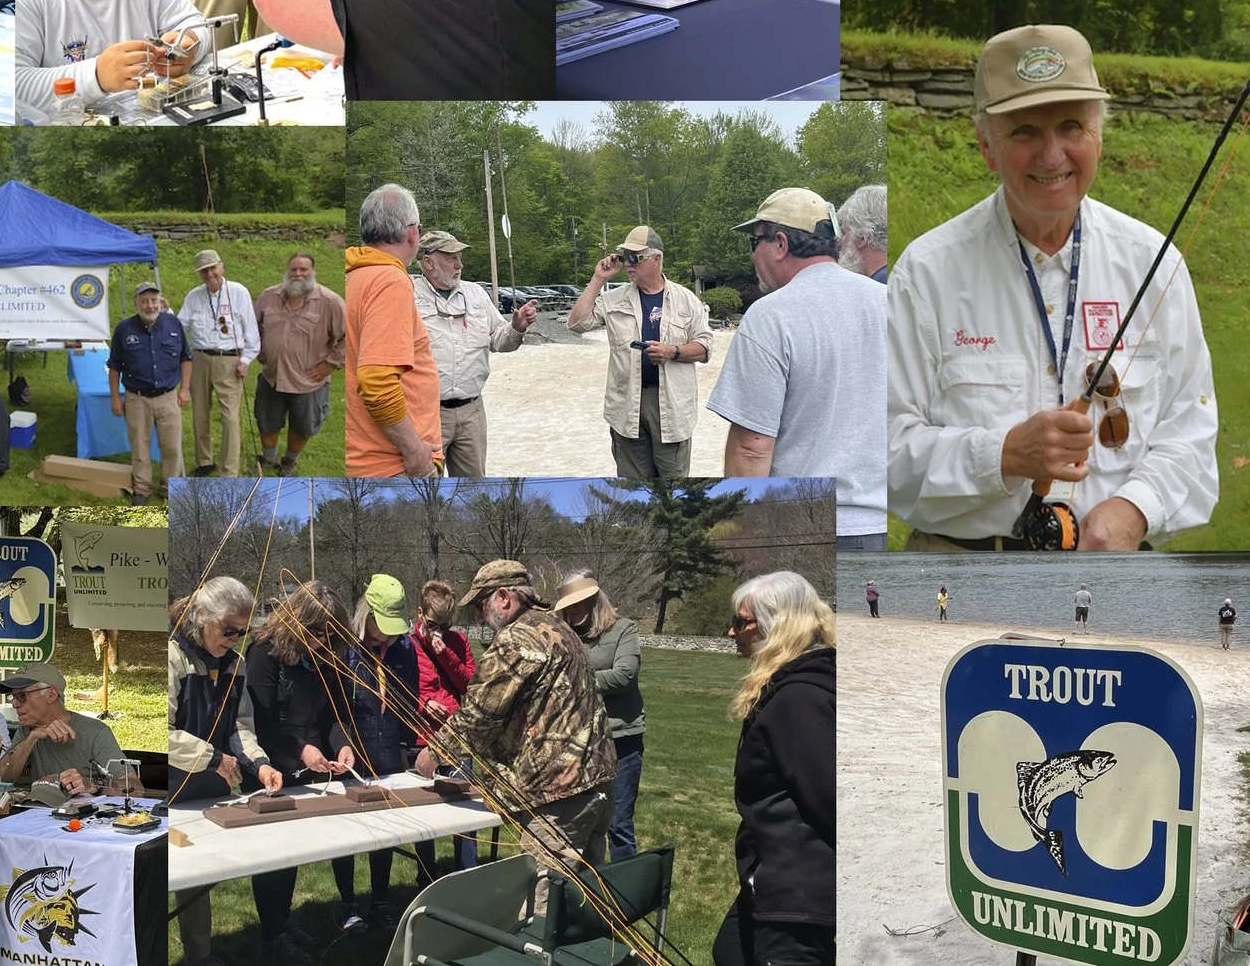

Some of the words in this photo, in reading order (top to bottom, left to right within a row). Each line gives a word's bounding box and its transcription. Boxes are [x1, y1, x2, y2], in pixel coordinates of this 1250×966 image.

[40, 284, 66, 295] #462
[954, 330, 996, 351] George
[110, 552, 140, 566] Pike
[156, 553, 168, 566] W
[72, 576, 106, 589] TROUT
[137, 577, 168, 590] TRO
[1004, 664, 1122, 707] TROUT
[971, 890, 1162, 962] UNLIMITED
